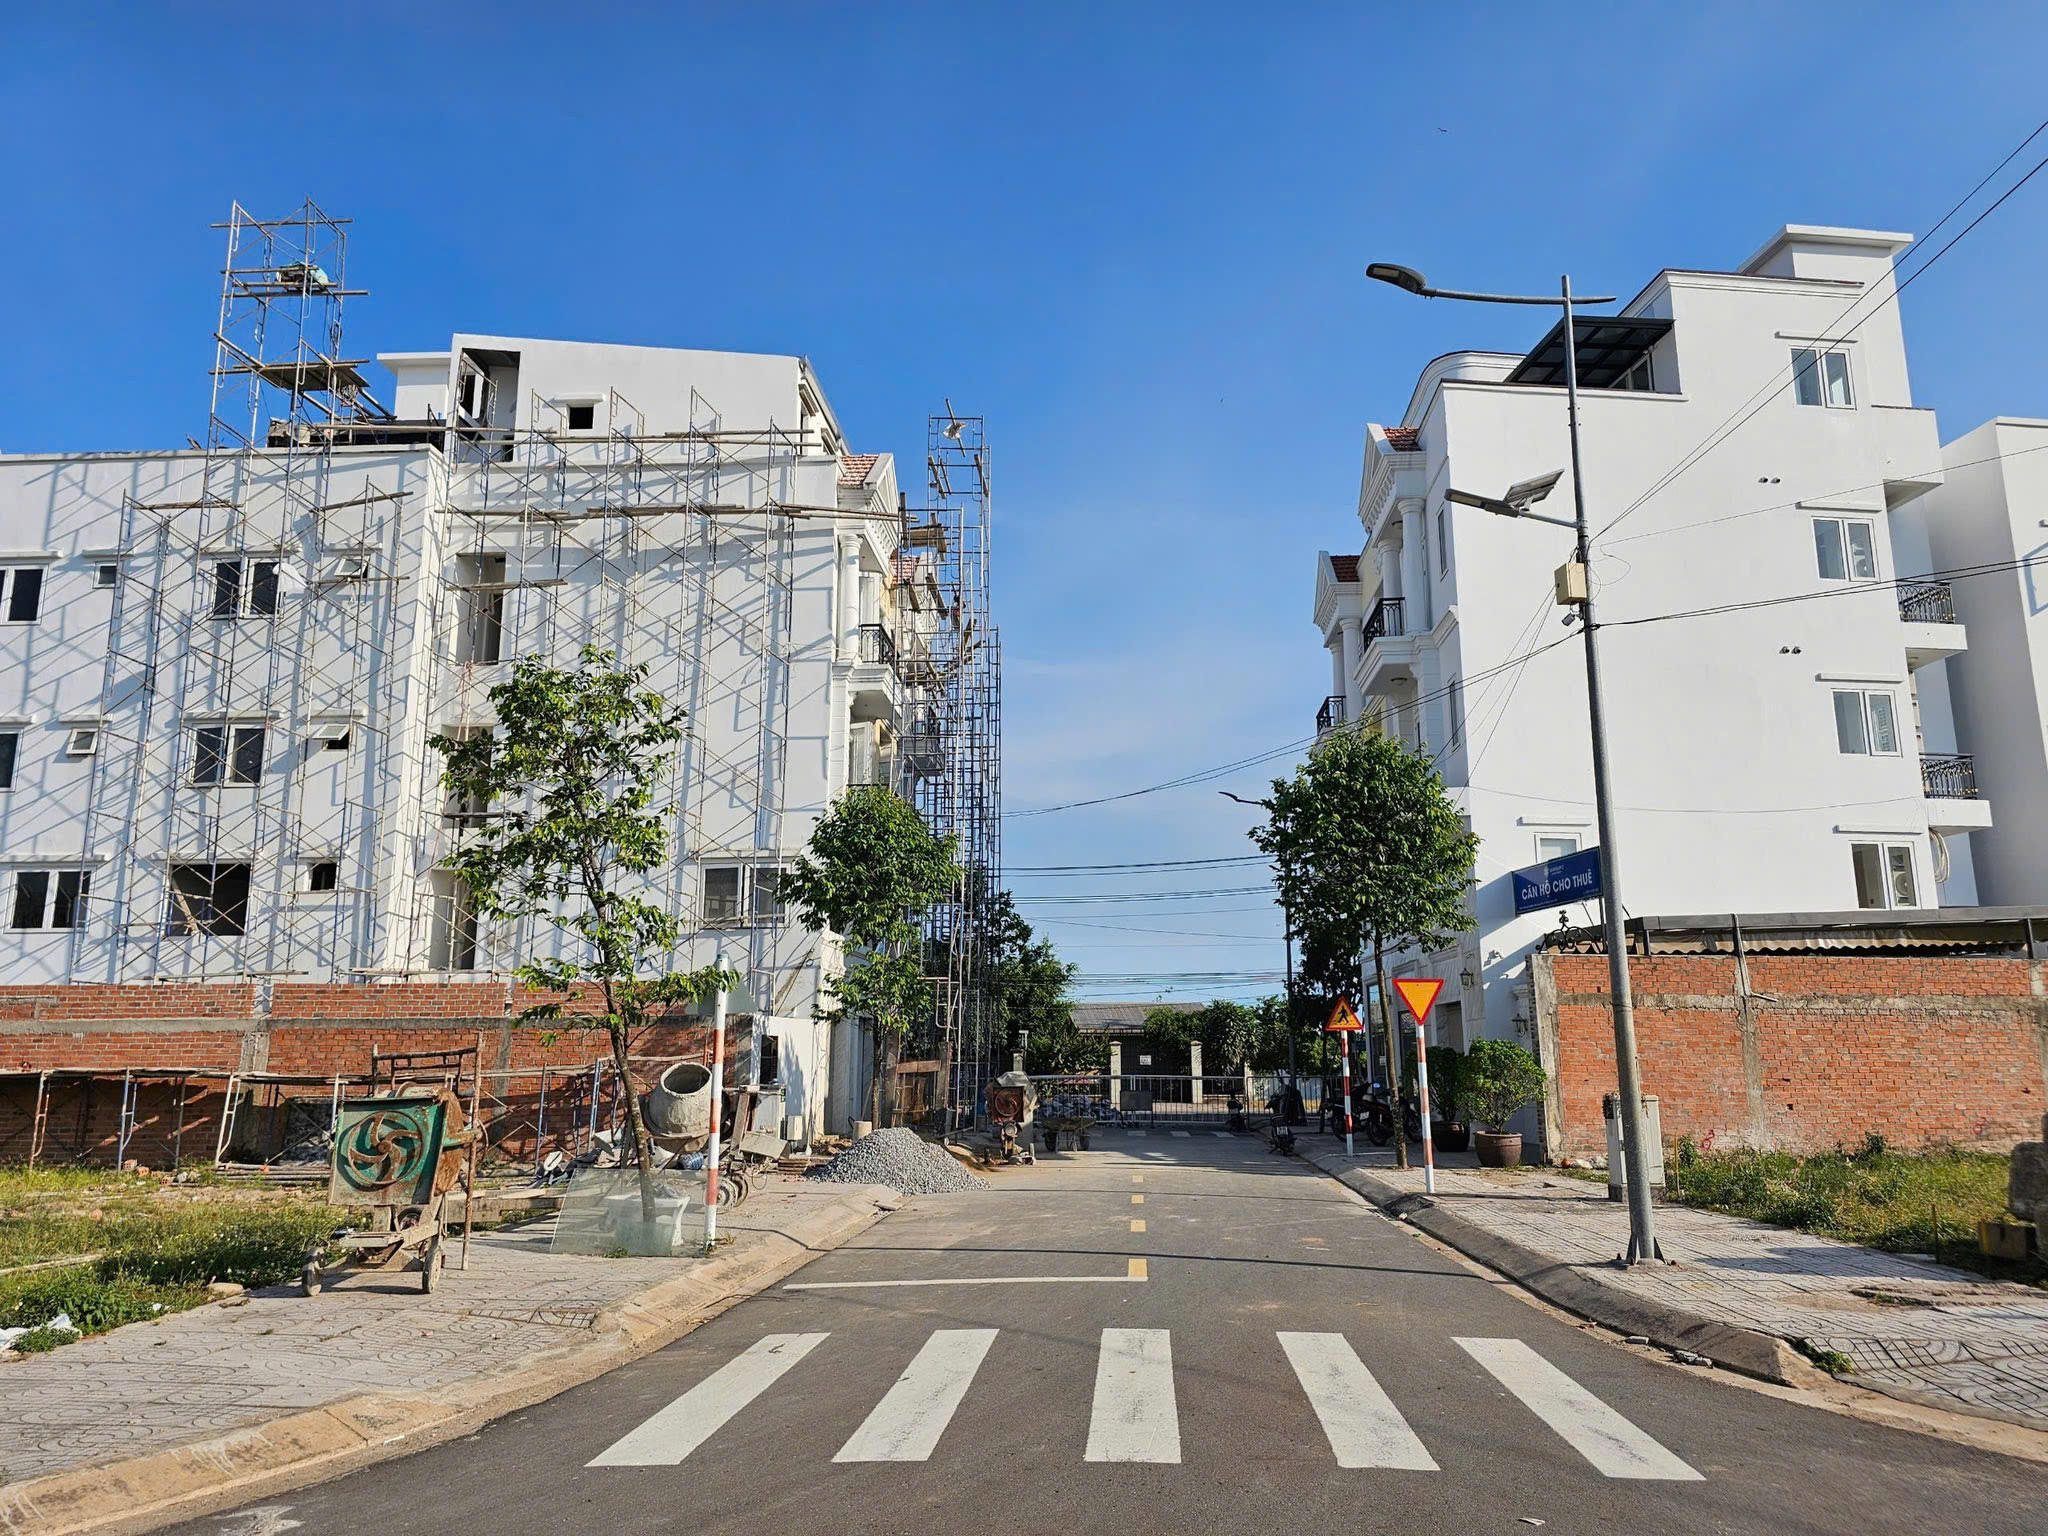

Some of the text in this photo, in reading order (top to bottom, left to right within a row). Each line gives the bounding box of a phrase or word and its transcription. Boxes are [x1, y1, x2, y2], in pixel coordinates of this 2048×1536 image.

[1522, 884, 1538, 900] CĂN
[1539, 880, 1551, 898] HỘ
[1552, 877, 1571, 892] CHO
[1572, 869, 1593, 887] THUÊ
